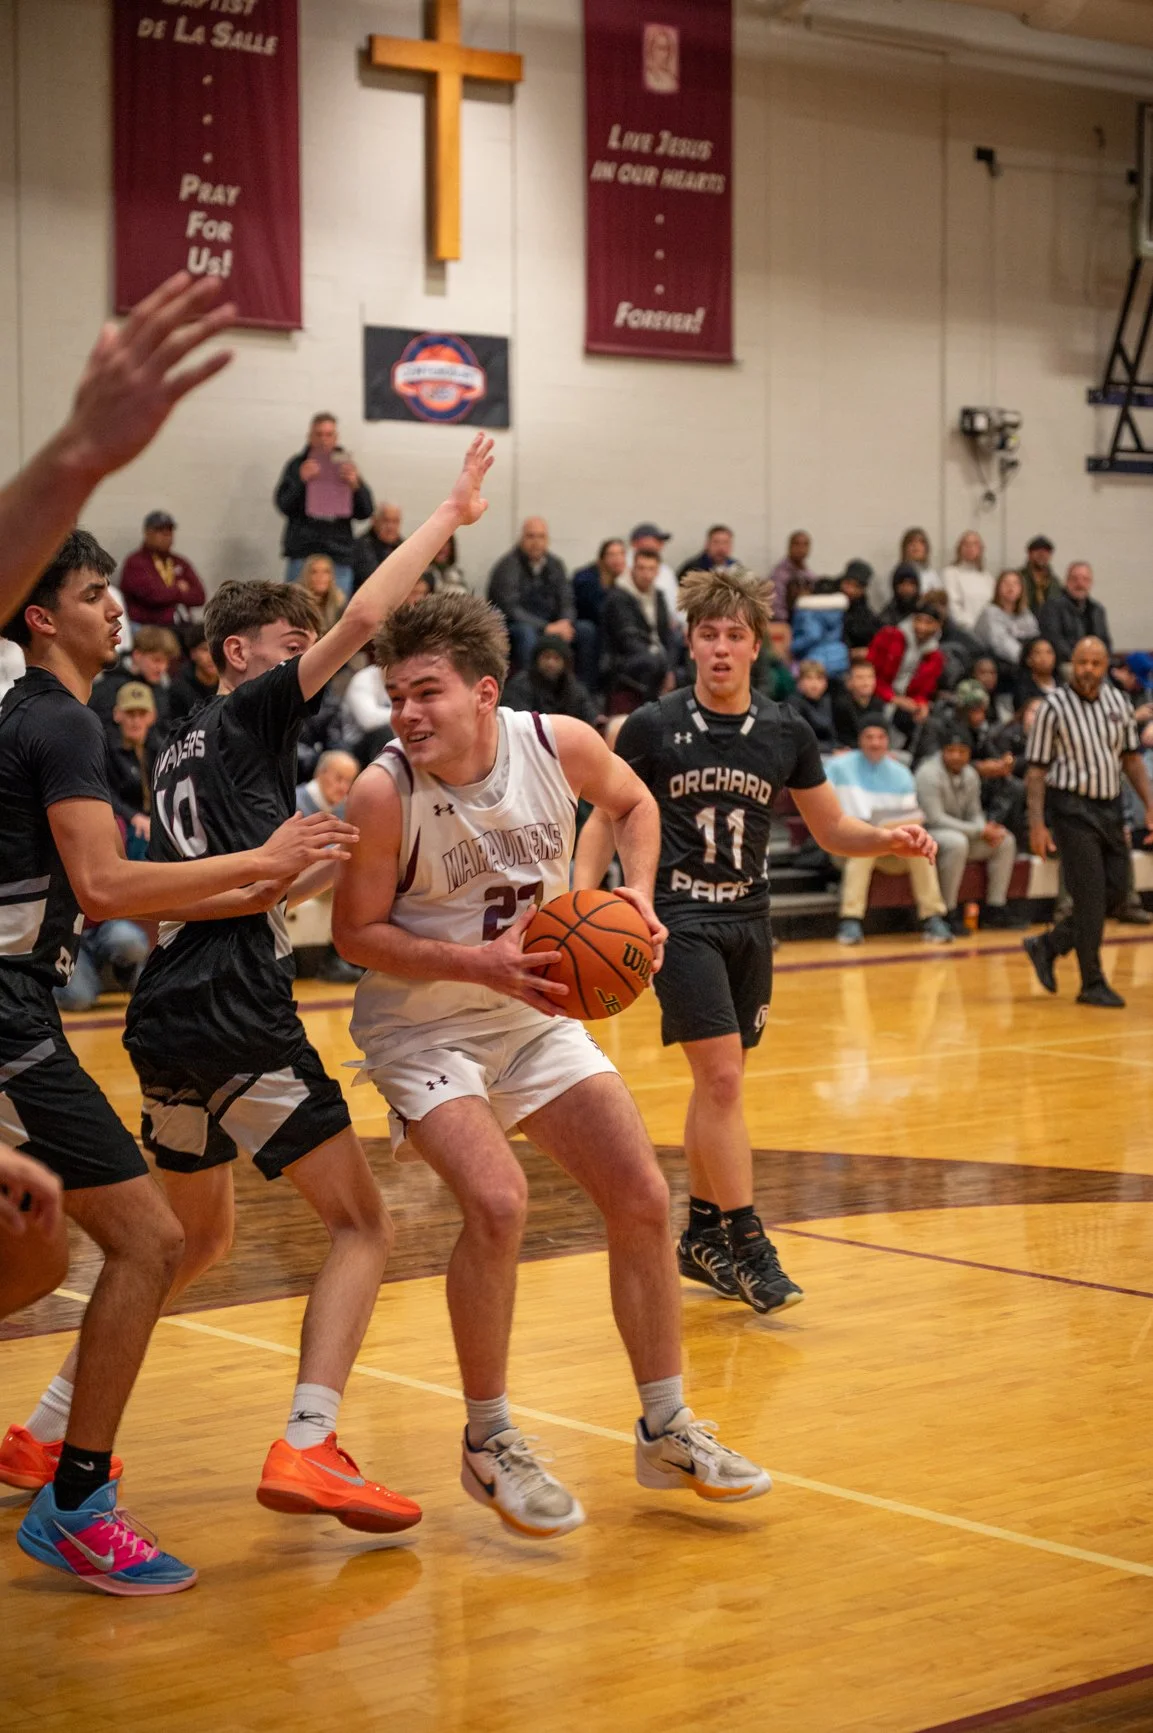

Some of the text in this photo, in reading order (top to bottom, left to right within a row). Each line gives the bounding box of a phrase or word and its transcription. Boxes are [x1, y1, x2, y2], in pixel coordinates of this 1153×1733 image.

[137, 15, 279, 55] DE LA SALLE
[179, 173, 241, 206] PRAY
[185, 211, 234, 241] FOR
[187, 246, 233, 278] US!
[153, 729, 206, 791] UAERS
[669, 766, 772, 805] ORCHARD
[156, 775, 208, 858] 10
[442, 822, 564, 895] MARAUDERS
[695, 807, 746, 870] 11
